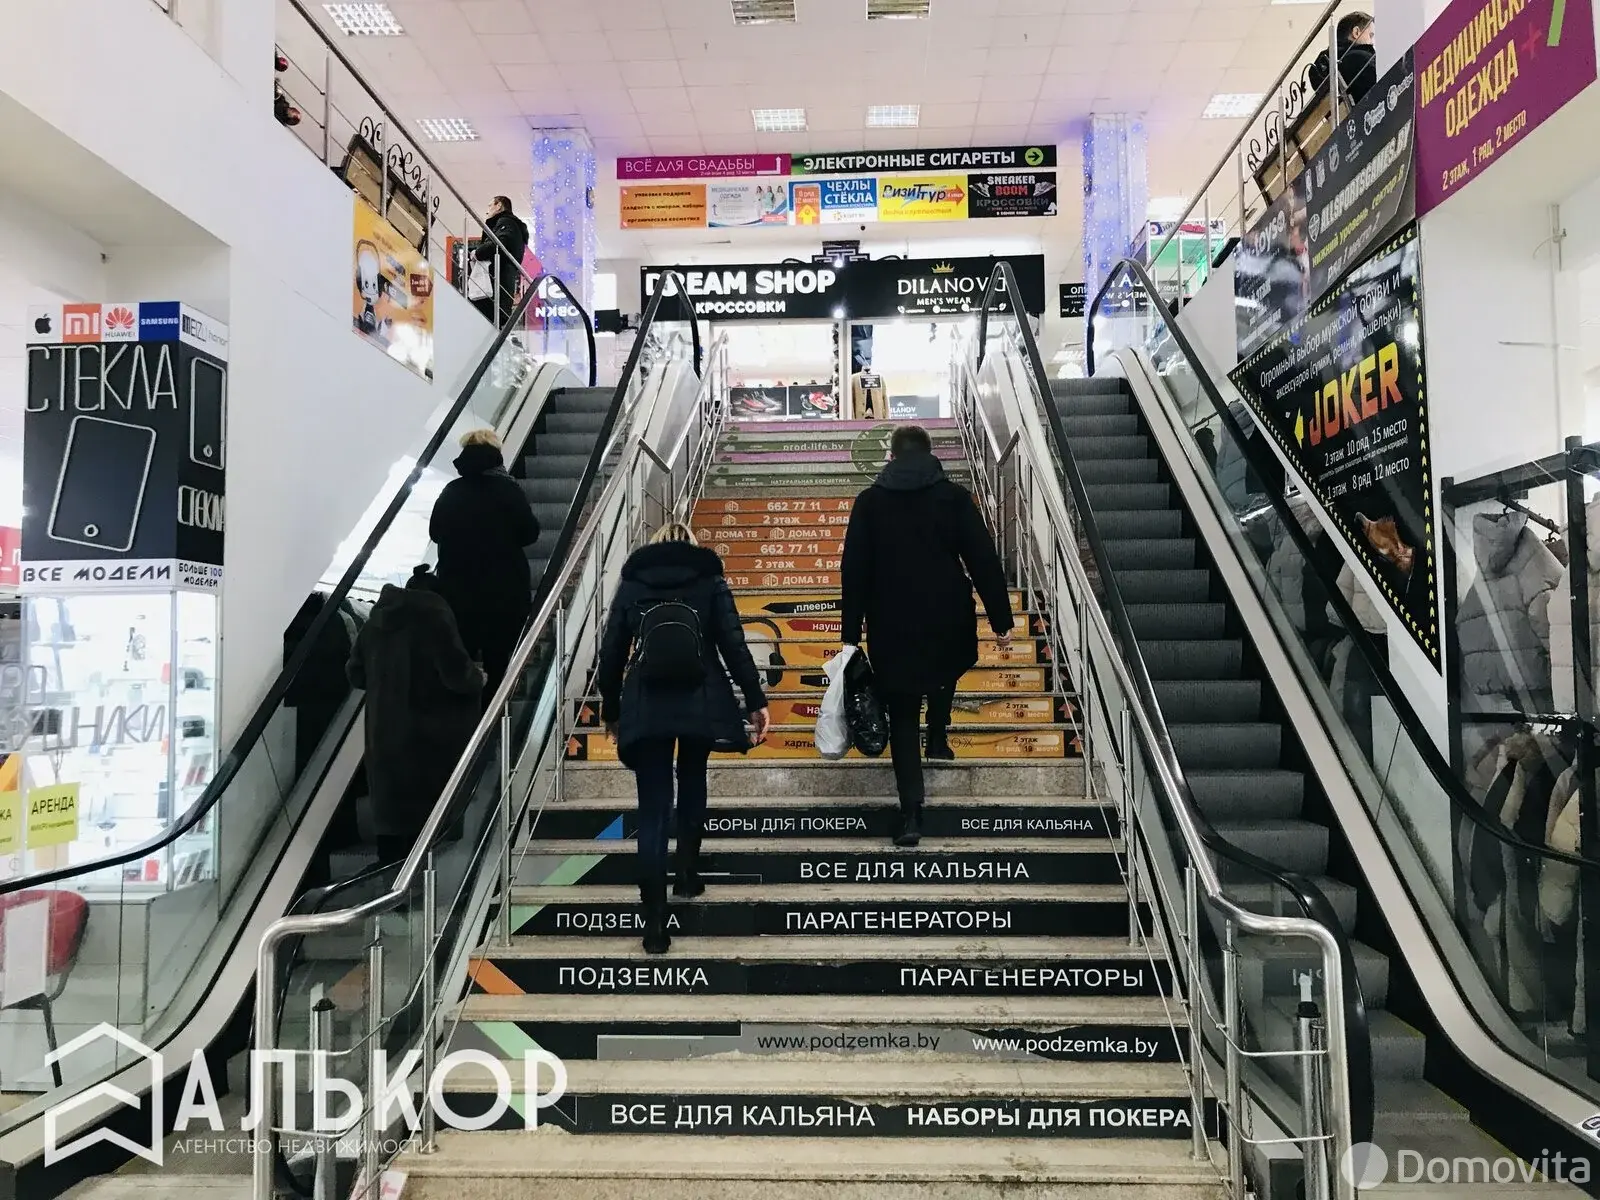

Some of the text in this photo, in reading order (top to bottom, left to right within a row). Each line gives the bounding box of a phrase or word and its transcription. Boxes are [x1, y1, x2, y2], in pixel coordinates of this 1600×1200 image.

[1421, 0, 1528, 108] МЕДИЦИНСК
[1445, 39, 1519, 138] ОДЕЖДА
[1442, 170, 1448, 191] 2
[1472, 146, 1477, 167] 1
[1496, 125, 1502, 148] 2
[1503, 109, 1527, 142] МЕСТО
[625, 158, 756, 173] ВСЁ ДЛЯ СВАДЬБЫ
[803, 151, 1016, 170] ЭЛЕКТРОННЫЕ СИГАРЕТЫ
[826, 180, 870, 192] ЧЕХЛЫ
[987, 175, 1036, 185] SNEAKER
[824, 192, 874, 204] СТЁКЛА
[976, 198, 1049, 207] КРОССОВКИ
[755, 270, 836, 294] SHOP
[897, 277, 989, 295] DILANOV
[695, 300, 786, 314] КРОССОВКИ
[916, 296, 972, 306] MEN'S WEAR
[1260, 271, 1400, 388] Огромный выбор мужской обуви и
[25, 344, 178, 412] СТЕКЛА
[1309, 341, 1403, 447] JOKER
[783, 443, 844, 451] prod-life.by
[1324, 419, 1408, 467] 2 этаж 10 ряд 15 место
[1327, 486, 1332, 500] 1
[1332, 482, 1347, 498] этаж
[1352, 474, 1357, 490] 8
[1358, 472, 1372, 491] ряд
[1374, 463, 1384, 481] 12
[1385, 457, 1410, 477] место
[767, 502, 788, 511] 662
[792, 502, 806, 510] 77
[809, 501, 821, 510] 11
[762, 514, 850, 525] 2 этаж 4 ряд
[715, 530, 758, 539] ДОМА ТВ
[788, 529, 817, 539] ДОМА
[819, 529, 831, 537] ТВ
[760, 544, 845, 554] 662 77 11 А
[178, 563, 222, 577] БОЛЬШЕ 100
[755, 558, 841, 570] 2 этаж 4 ря
[23, 565, 171, 582] ВСЕ МОДЕЛИ
[736, 576, 749, 585] ТВ
[782, 575, 829, 585] ДОМА ТВ
[796, 601, 836, 612] плееры
[812, 622, 842, 631] науш
[31, 796, 75, 815] АРЕНДА
[704, 817, 867, 833] БОРЫ ДЛЯ ПОКЕРА
[961, 818, 1094, 832] ВСЕ ДЛЯ КАЛЬЯНА
[800, 862, 1030, 881] ВСЕ ДЛЯ КАЛЬЯНА
[556, 912, 681, 931] ПОДЗЕМА
[785, 911, 1012, 929] ПАРАГЕНЕРАТОРЫ
[558, 966, 709, 989] ПОДЗЕМКА
[900, 968, 1144, 988] ПАРАГЕНЕРАТОРЫ
[757, 1032, 941, 1052] www.podzemka.by
[972, 1035, 1159, 1057] www.podzemka.by
[611, 1104, 876, 1129] ВСЕ ДЛЯ КАЛЬЯНА
[907, 1107, 1192, 1130] НАБОРЫ ДЛЯ ПОКЕРА
